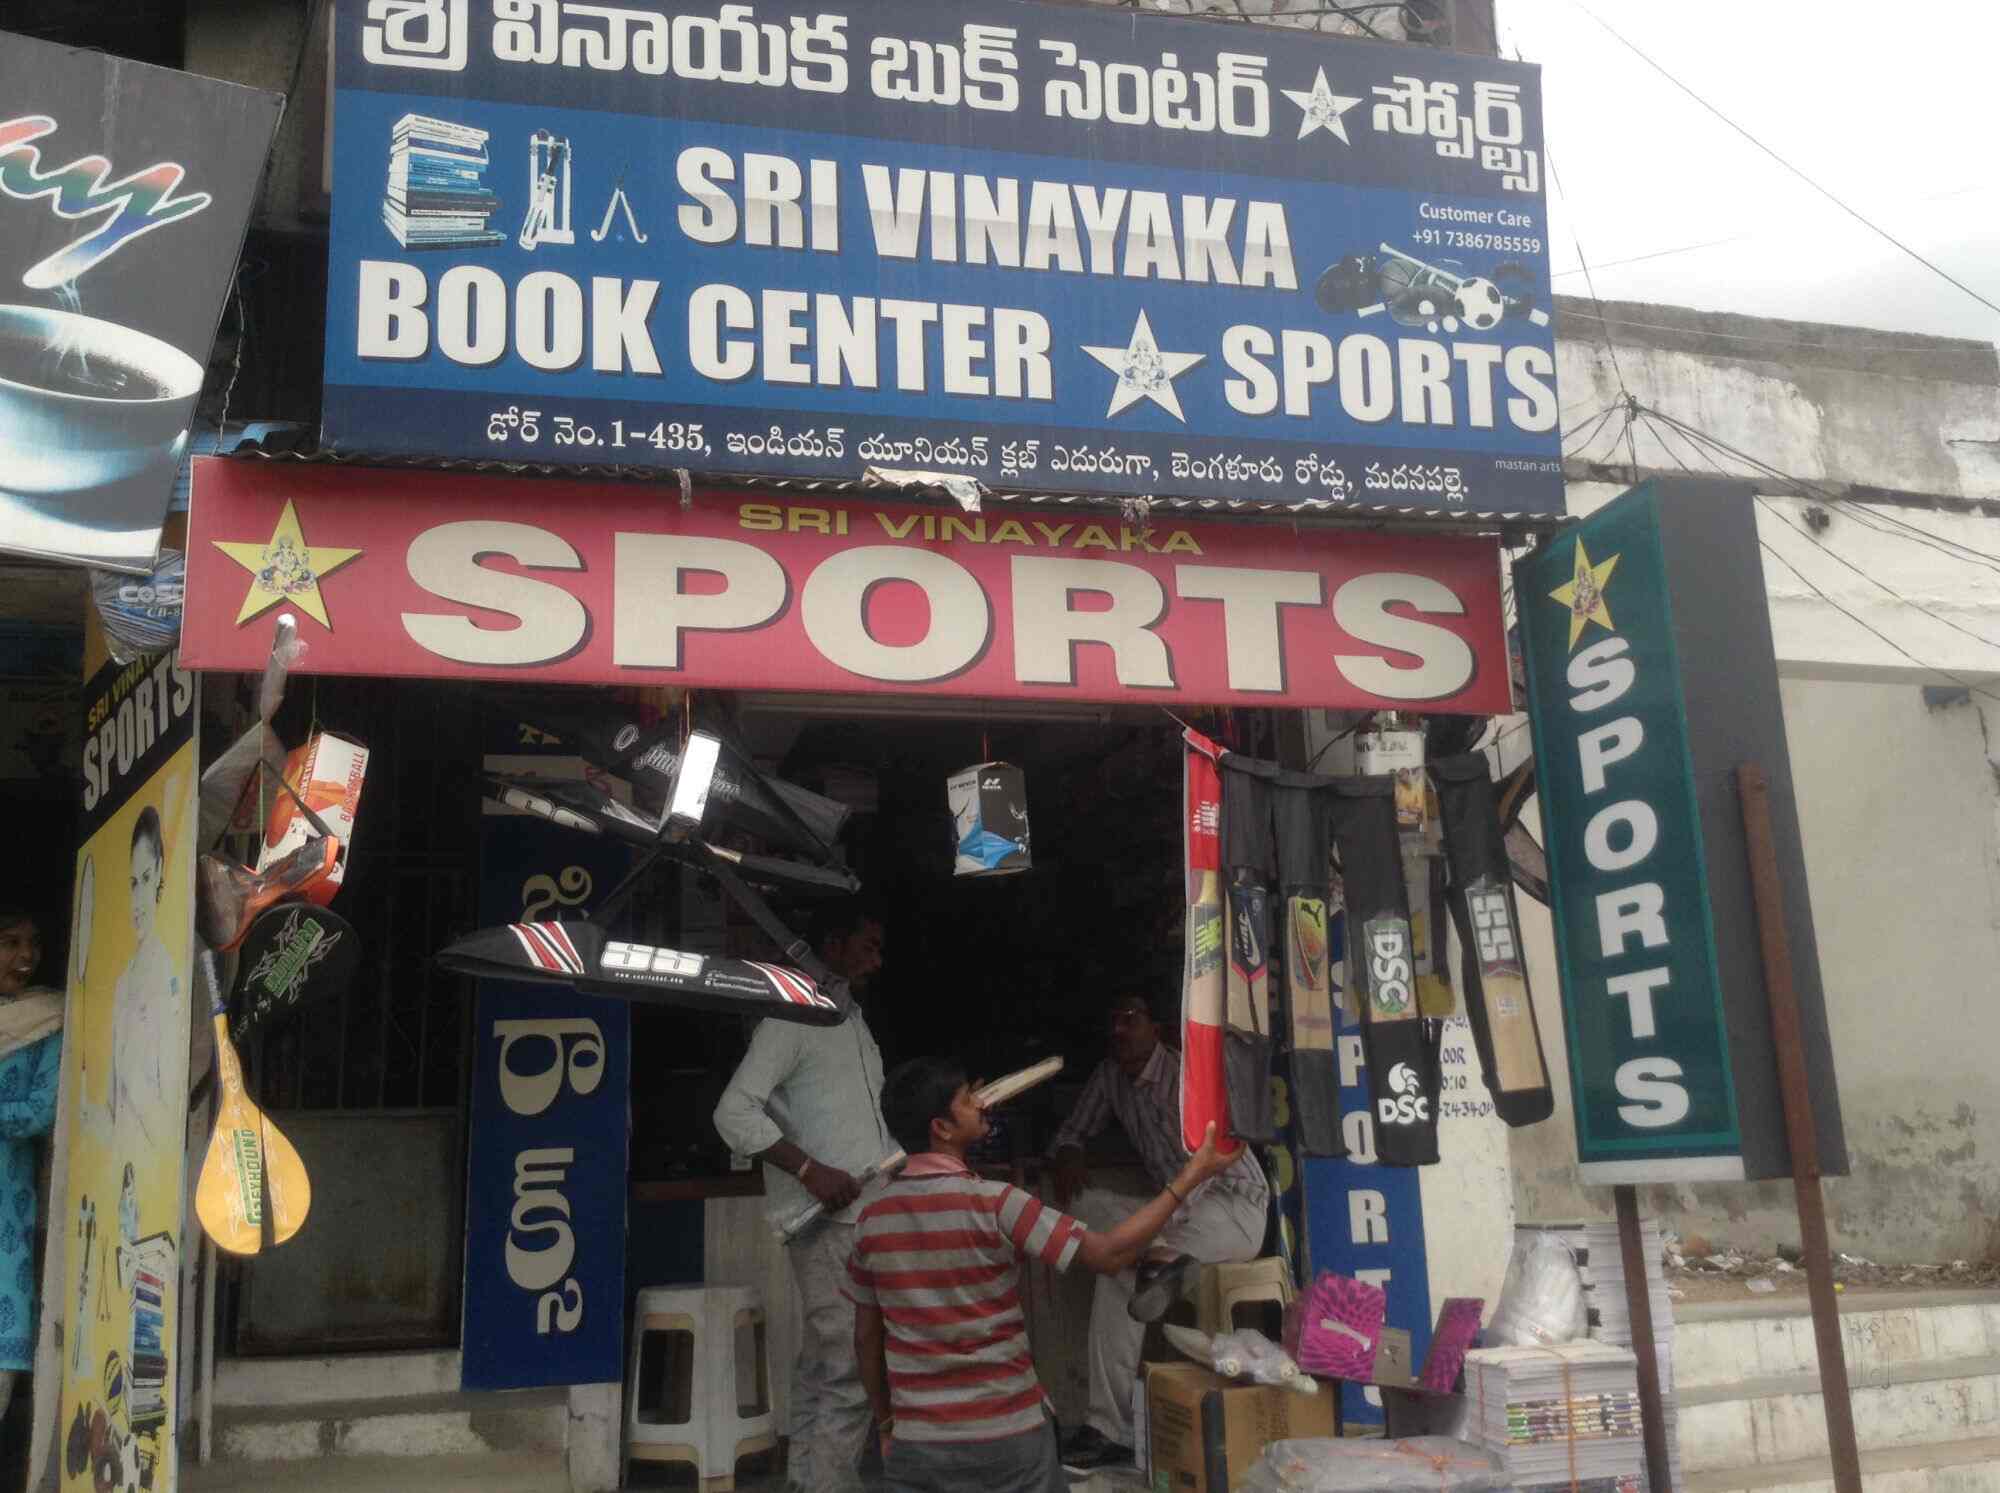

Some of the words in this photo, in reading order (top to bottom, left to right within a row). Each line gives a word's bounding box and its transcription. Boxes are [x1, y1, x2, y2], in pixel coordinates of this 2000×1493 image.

[870, 24, 1019, 112] బుక్
[1039, 40, 1271, 137] సెంటర్
[676, 146, 840, 253] SRI
[861, 163, 1298, 291] VINAYAKA
[1412, 228, 1441, 245] +91
[1446, 231, 1541, 254] 7386785559
[1419, 202, 1493, 224] Customer
[1497, 209, 1532, 228] Care
[357, 259, 664, 376] BOOK
[688, 283, 1053, 401] CENTER
[1221, 324, 1557, 434] SPORTS
[487, 405, 542, 443] డోర్
[726, 426, 845, 459] ఇండియన్
[738, 504, 848, 535] SRI
[875, 512, 1204, 555] VINAYAKA
[400, 520, 1475, 700] SPORTS
[83, 650, 193, 812] SPORTS
[1567, 635, 1690, 1128] SPORTS
[1373, 932, 1409, 1006] DSC
[1378, 1095, 1429, 1124] DSC
